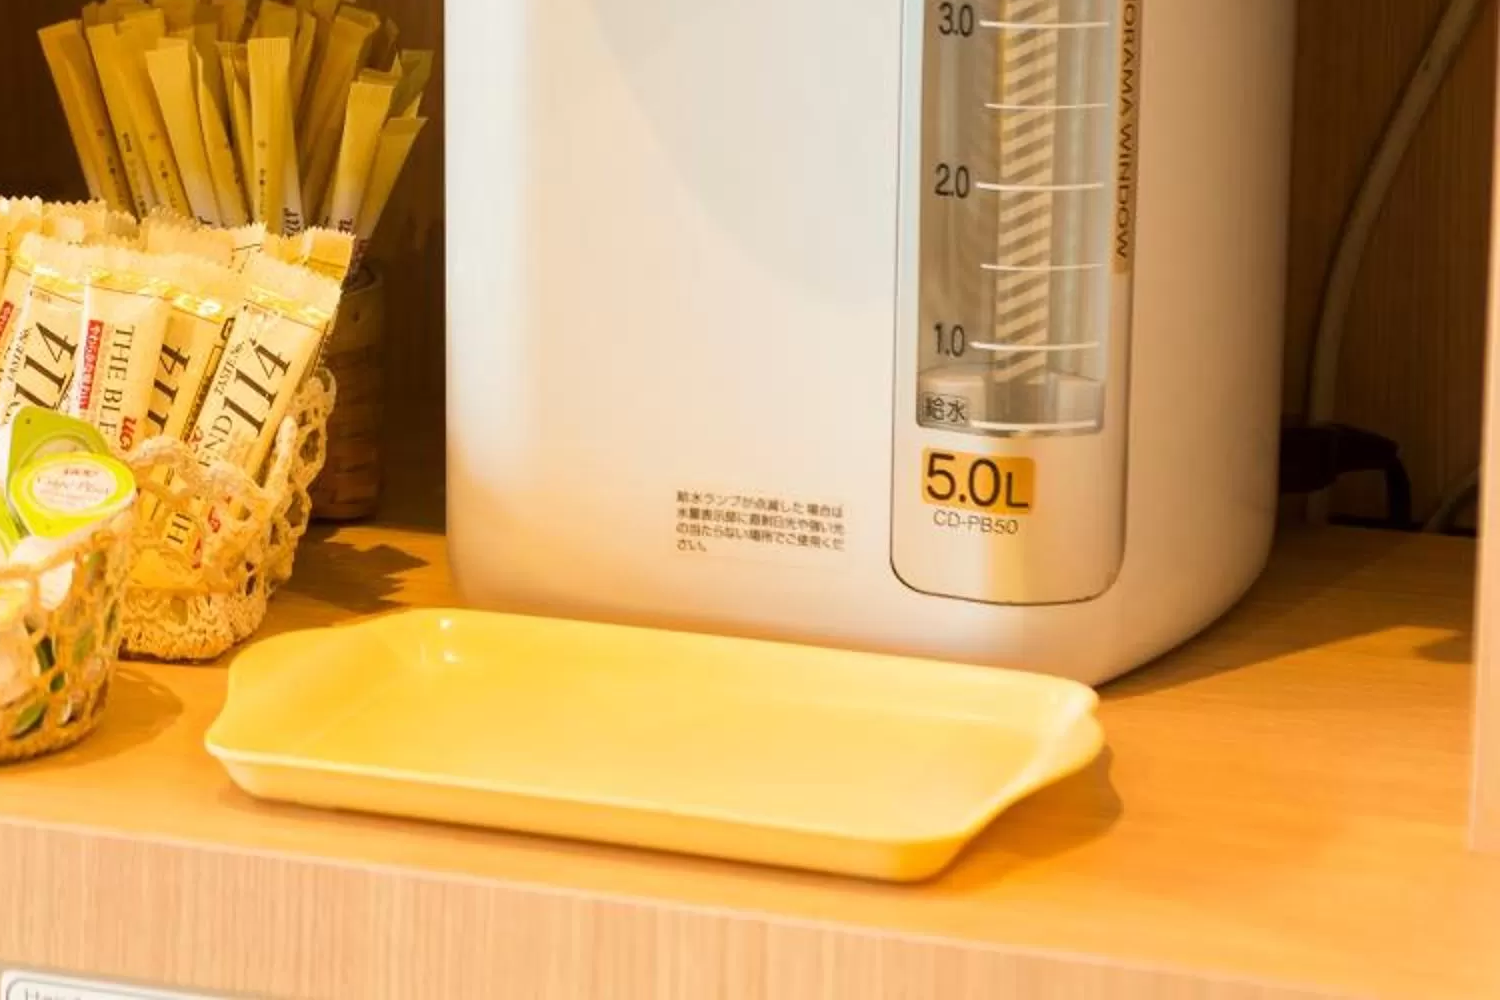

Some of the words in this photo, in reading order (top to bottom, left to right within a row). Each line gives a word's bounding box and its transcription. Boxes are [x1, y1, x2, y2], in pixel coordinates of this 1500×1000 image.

[938, 2, 974, 37] 3.0
[934, 163, 970, 199] 2.0
[1115, 123, 1134, 258] WINDOW
[107, 325, 135, 381] THE
[933, 323, 966, 357] 1.0
[15, 321, 79, 410] 114
[146, 343, 190, 434] 114
[214, 352, 237, 395] TASTE
[217, 343, 292, 437] 114
[925, 396, 966, 423] 給水
[926, 452, 1030, 509] 5.0L
[933, 510, 1019, 535] CD-PB50
